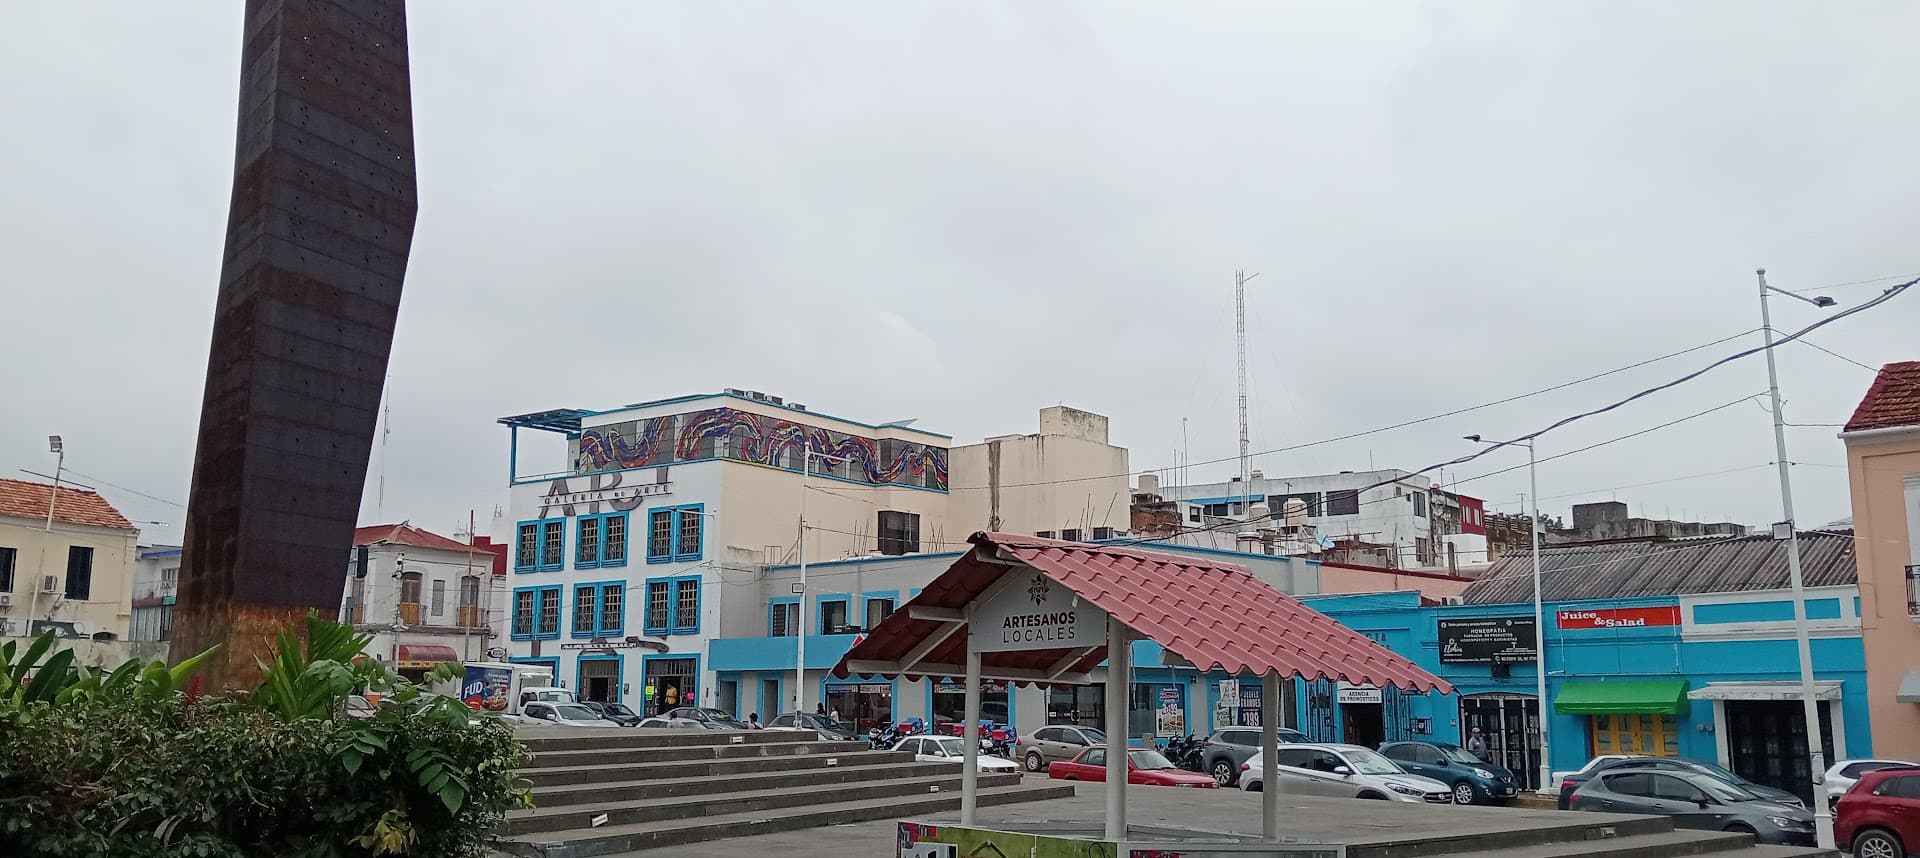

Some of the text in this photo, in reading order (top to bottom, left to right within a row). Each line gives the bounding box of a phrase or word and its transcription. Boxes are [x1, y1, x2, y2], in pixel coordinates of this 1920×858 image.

[544, 492, 603, 505] GALERIA
[634, 485, 668, 497] ARTE
[1003, 611, 1076, 629] ARTESANOS
[1561, 611, 1597, 620] Juice
[1605, 618, 1646, 628] Salad
[1003, 626, 1076, 643] LOCALES
[464, 681, 483, 699] FUD
